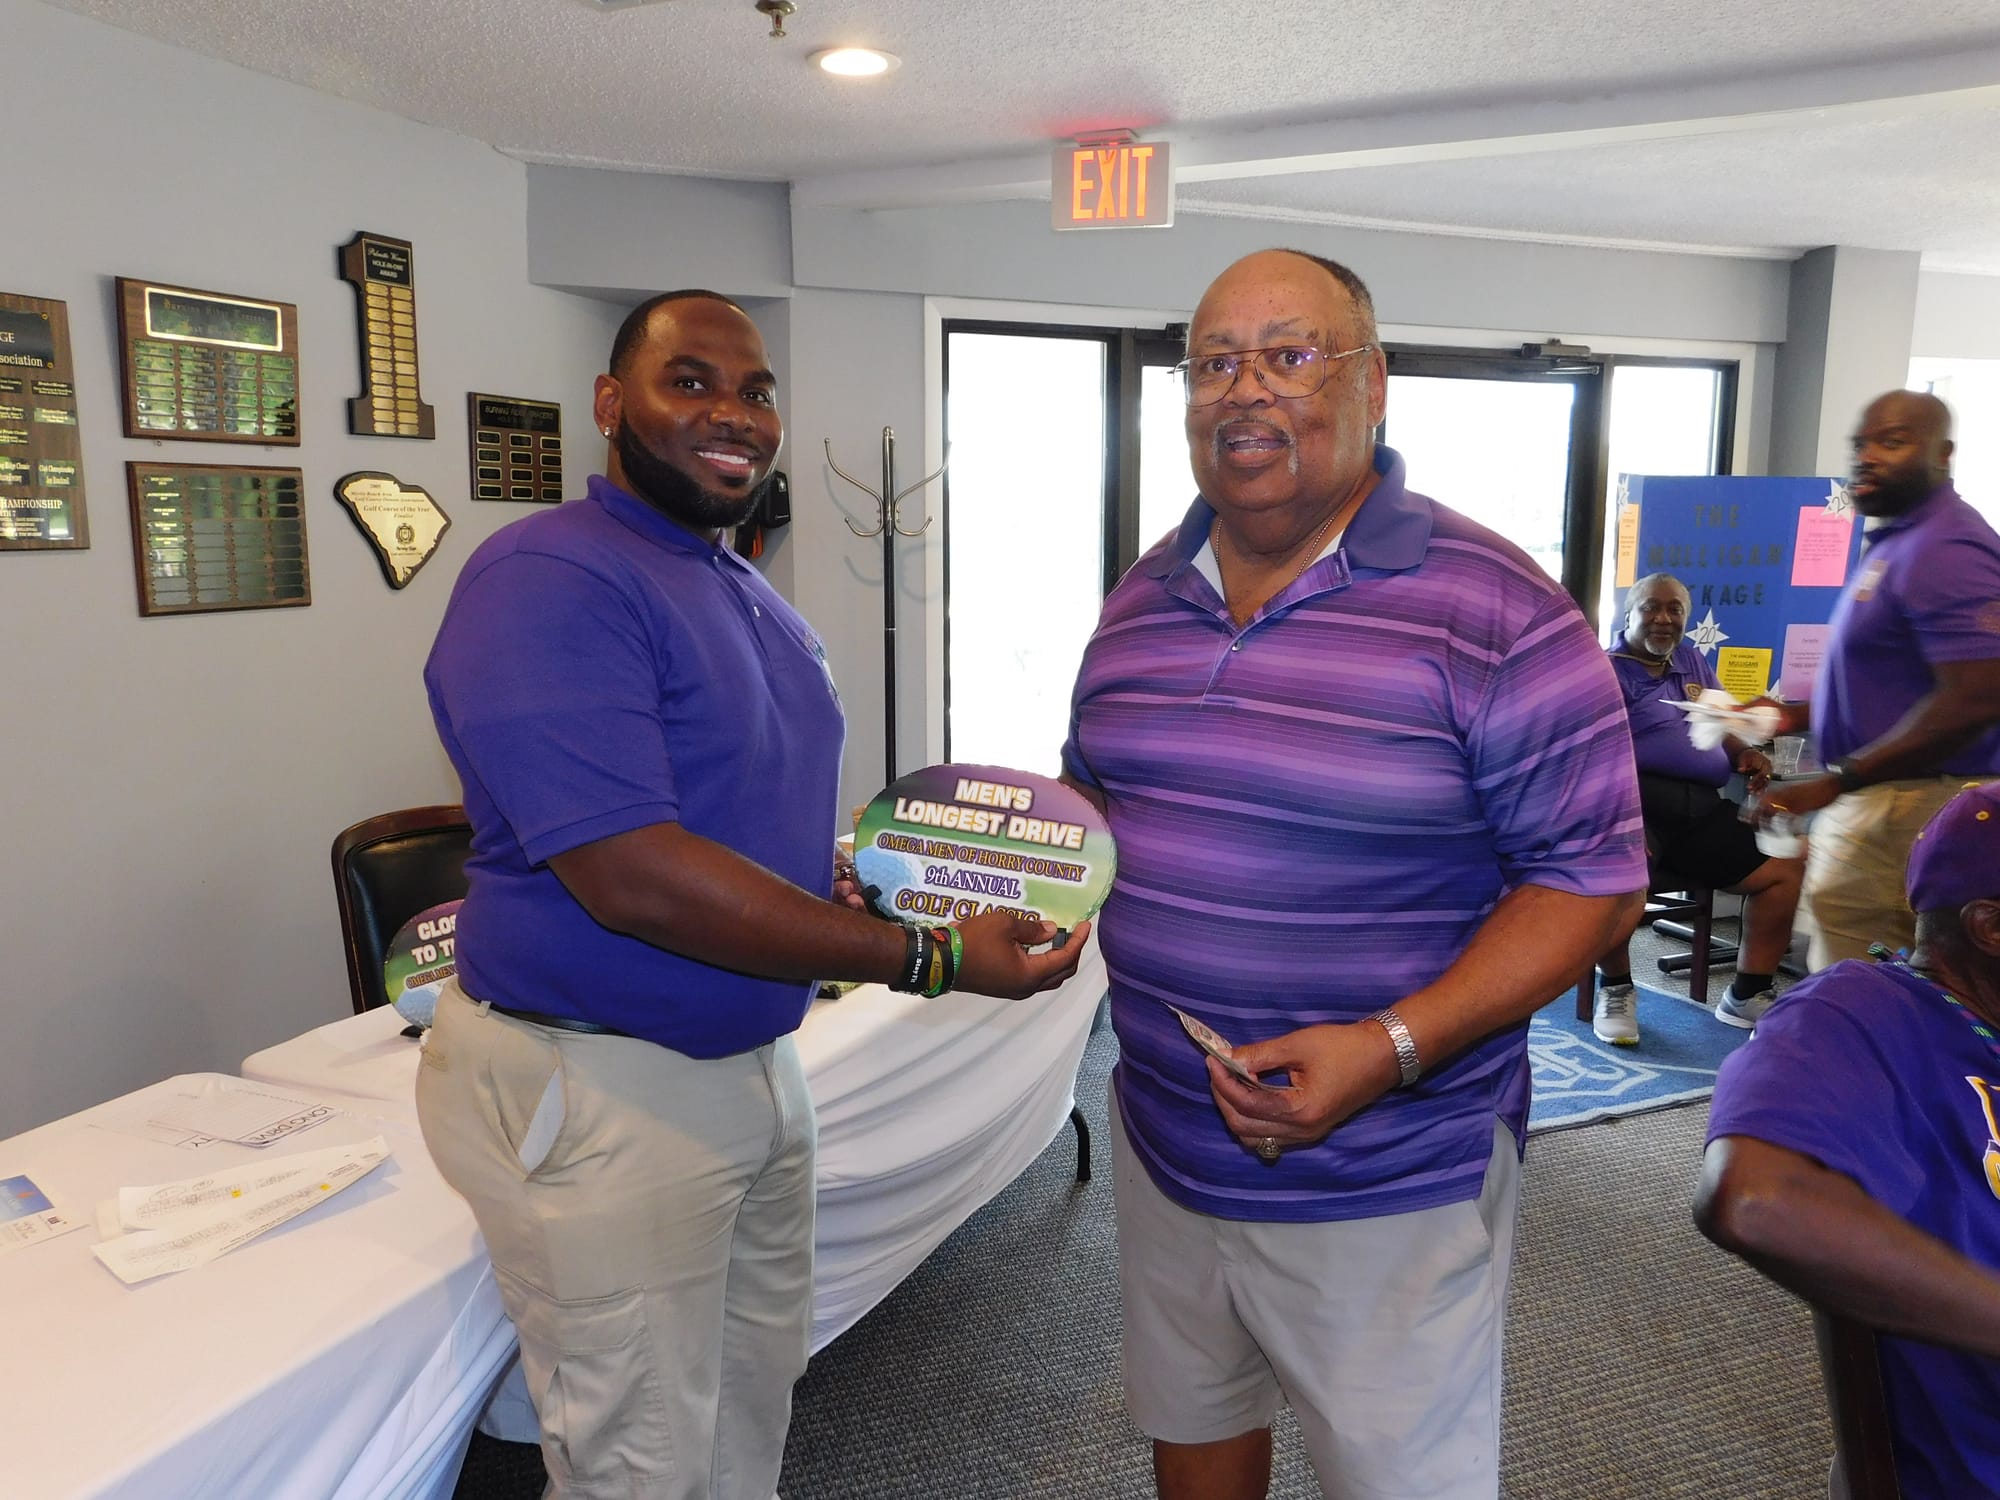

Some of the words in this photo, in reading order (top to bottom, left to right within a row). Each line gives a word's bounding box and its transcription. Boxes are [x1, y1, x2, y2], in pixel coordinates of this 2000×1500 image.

[1072, 147, 1153, 220] EXIT
[1695, 504, 1740, 528] THE
[1689, 583, 1765, 606] KAGE
[954, 779, 1033, 811] MEN'S
[894, 797, 1005, 835] LONGEST
[1007, 815, 1085, 849] DRIVE
[878, 833, 923, 854] OMEGA
[926, 840, 956, 859] MEN
[958, 847, 976, 862] OF
[977, 850, 1024, 871] HORRY
[1026, 858, 1085, 881] COUNTY
[926, 867, 948, 886] 9th
[951, 873, 1020, 898] ANNUAL
[897, 890, 953, 916] GOLF
[411, 944, 437, 966] TO
